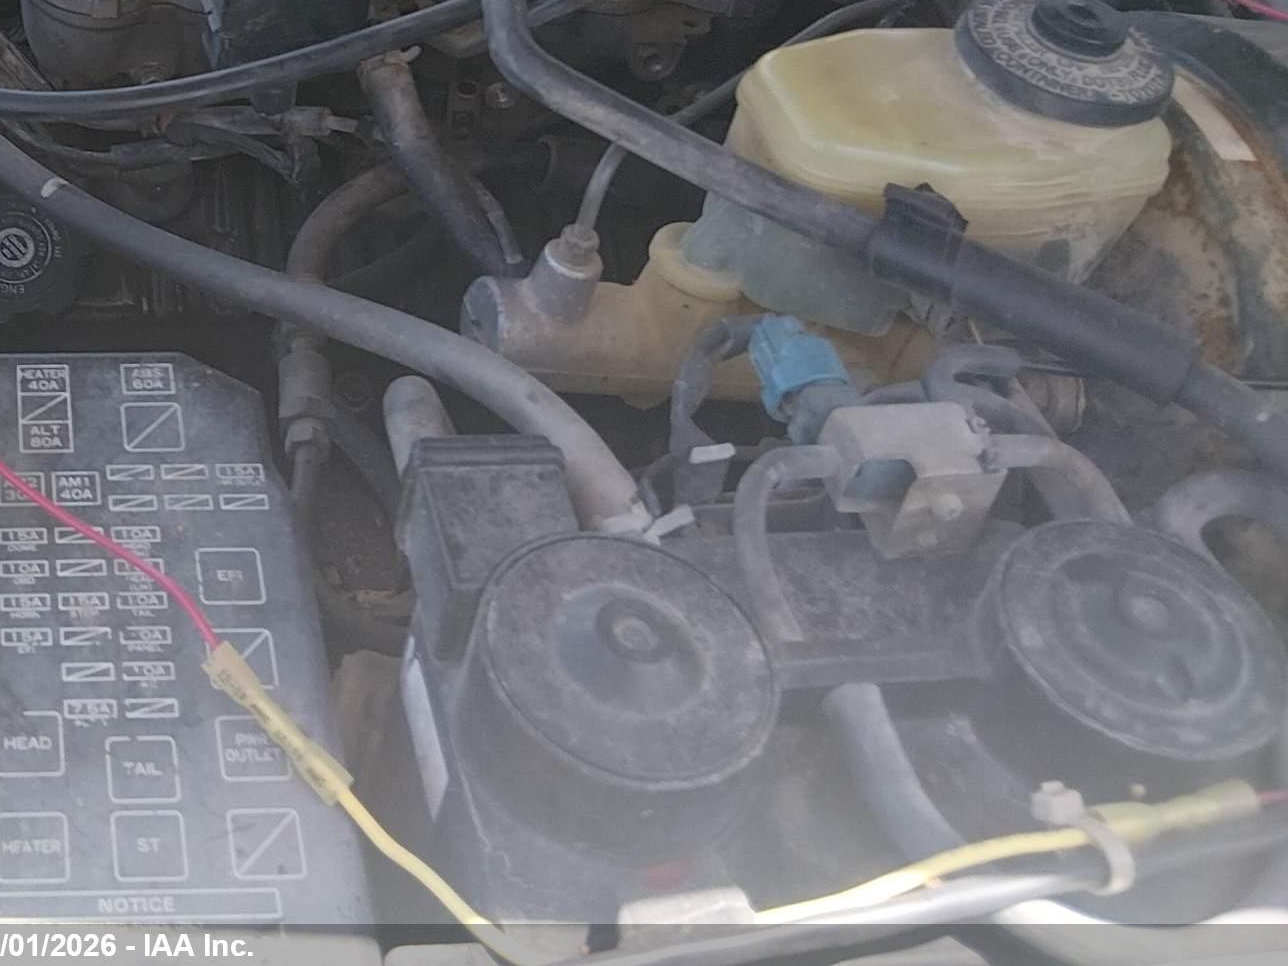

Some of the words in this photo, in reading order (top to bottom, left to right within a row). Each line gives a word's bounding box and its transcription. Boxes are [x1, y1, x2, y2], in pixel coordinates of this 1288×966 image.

[19, 368, 67, 380] HEATER
[131, 368, 162, 379] ABS
[27, 379, 59, 390] 40A
[132, 378, 164, 390] 60A
[30, 425, 59, 436] ALT
[30, 436, 62, 448] 80A
[58, 476, 90, 487] AM1
[59, 488, 93, 500] 40A
[8, 530, 39, 540] 15A
[122, 528, 152, 538] 10A
[10, 562, 40, 573] 10A
[11, 596, 42, 607] 15A
[69, 595, 101, 606] 15A
[128, 596, 159, 605] 10A
[12, 631, 43, 642] 15A
[3, 737, 53, 751] HEAD
[123, 761, 163, 777] TAIL
[1, 839, 62, 855] HEATER
[136, 838, 161, 853] ST
[98, 896, 176, 914] NOTICE
